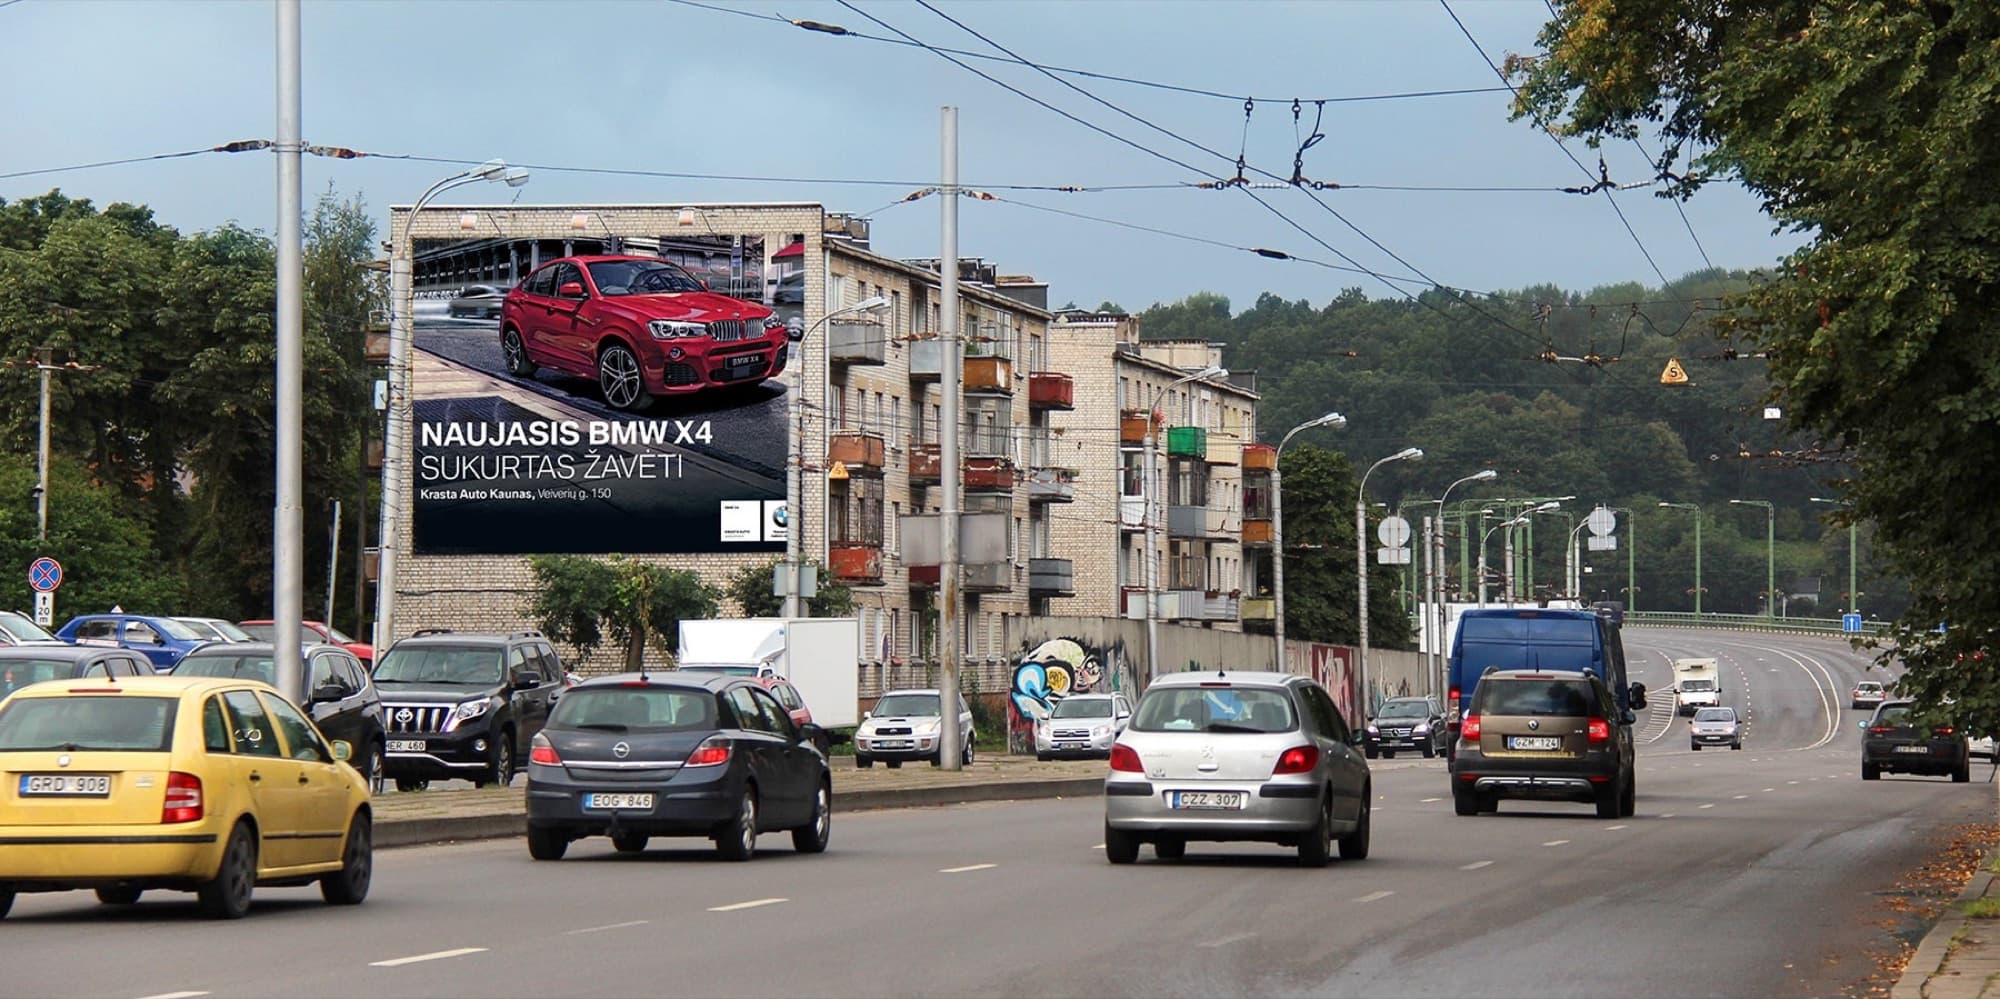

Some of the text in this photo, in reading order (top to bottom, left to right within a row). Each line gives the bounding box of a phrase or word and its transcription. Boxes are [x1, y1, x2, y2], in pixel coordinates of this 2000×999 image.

[1670, 367, 1678, 377] S
[421, 420, 713, 447] NAUJASIS BMW X4
[421, 448, 682, 480] SUKURTAS ŽAVĖTI
[421, 488, 612, 500] Krasta Auto Kaunas, Veiverių g. 150
[38, 607, 50, 616] 20
[408, 741, 424, 750] 460
[30, 777, 107, 792] GRD 908
[592, 795, 650, 807] EOG 846
[1181, 793, 1238, 805] CZZ 307
